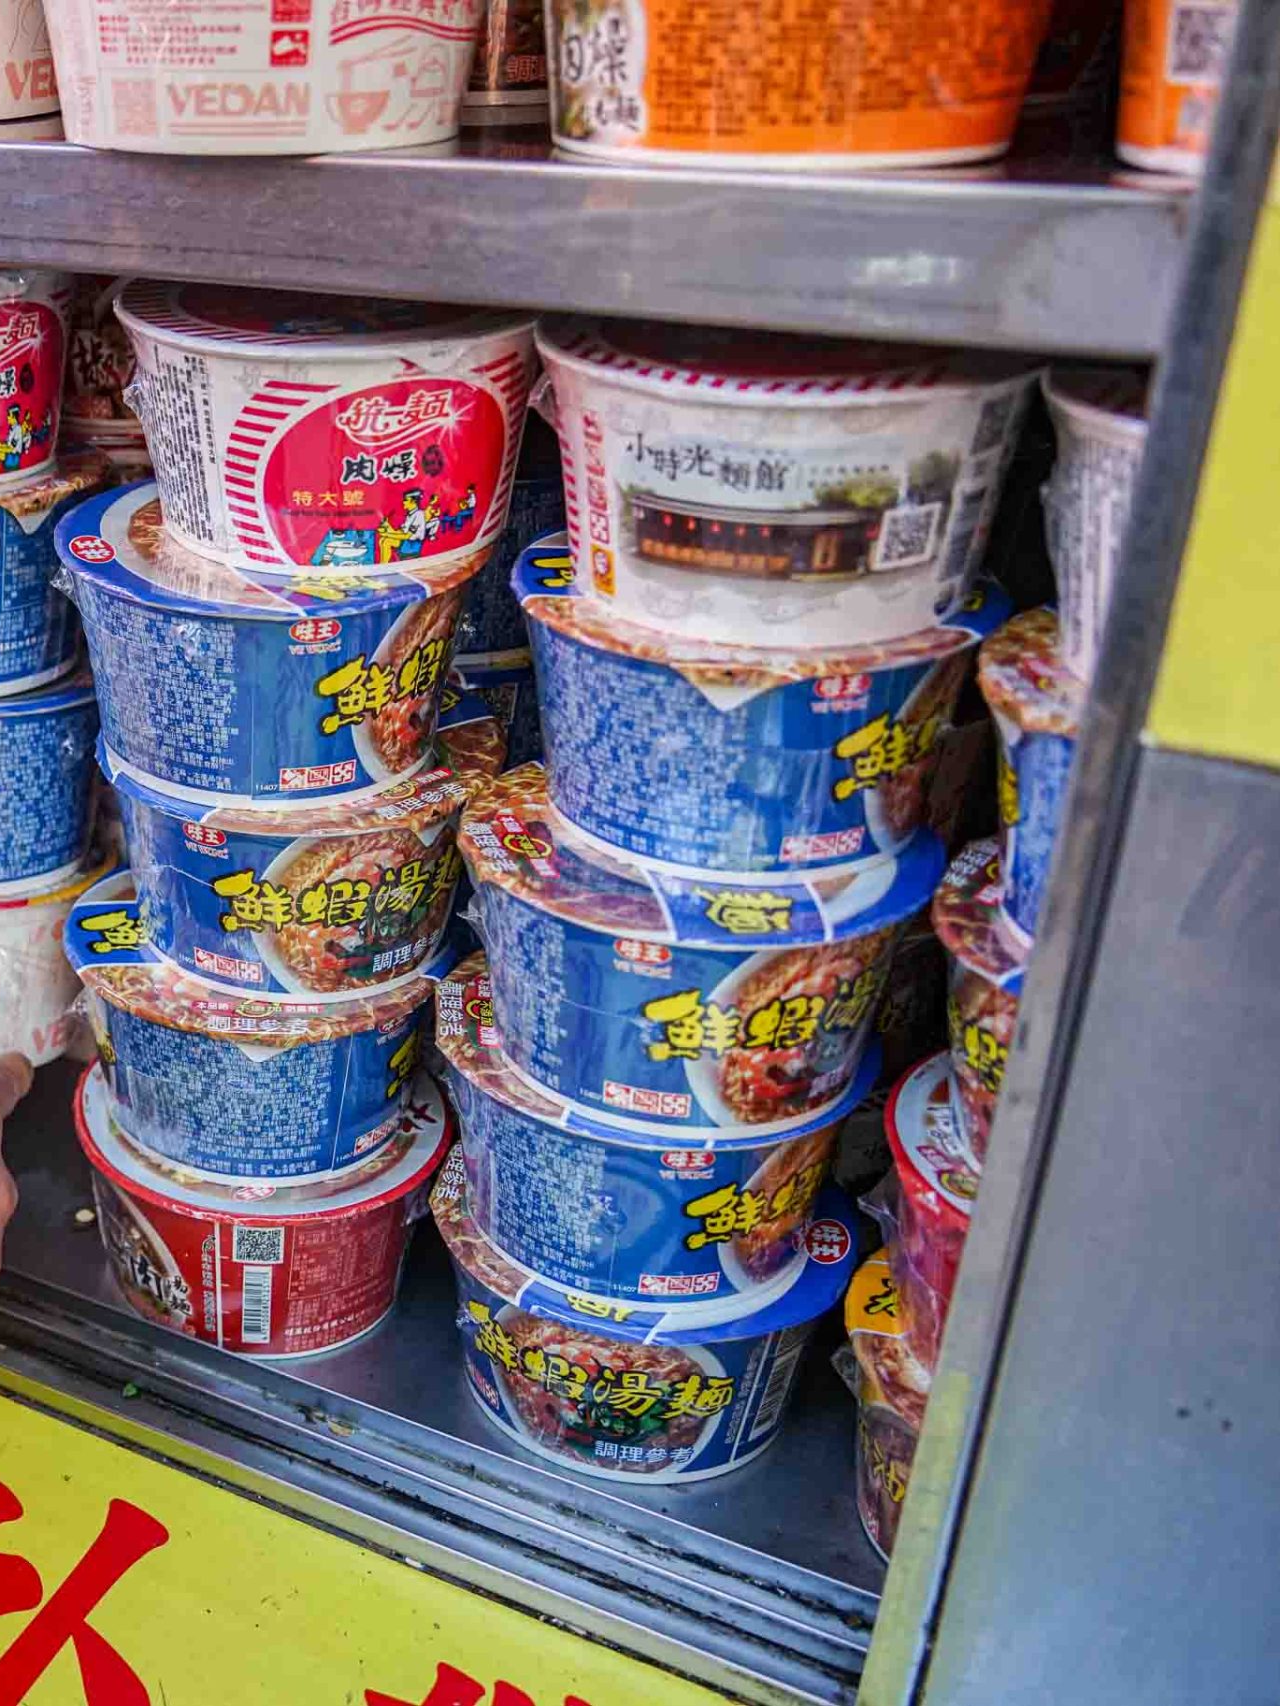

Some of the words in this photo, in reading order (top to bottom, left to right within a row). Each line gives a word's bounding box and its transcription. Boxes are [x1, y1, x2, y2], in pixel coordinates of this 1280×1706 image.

[4, 57, 57, 101] VE
[168, 83, 311, 117] VEDAN
[336, 389, 453, 434] 統一麵
[341, 450, 418, 485] 肉燥
[627, 432, 791, 492] 小時光麵館
[292, 490, 366, 507] 特大號
[295, 619, 335, 641] 味王
[372, 930, 441, 973] 調理參考
[206, 1016, 311, 1034] 調理參考
[468, 1300, 735, 1421] 鮮蝦湯麵
[594, 1440, 694, 1464] 調理參考
